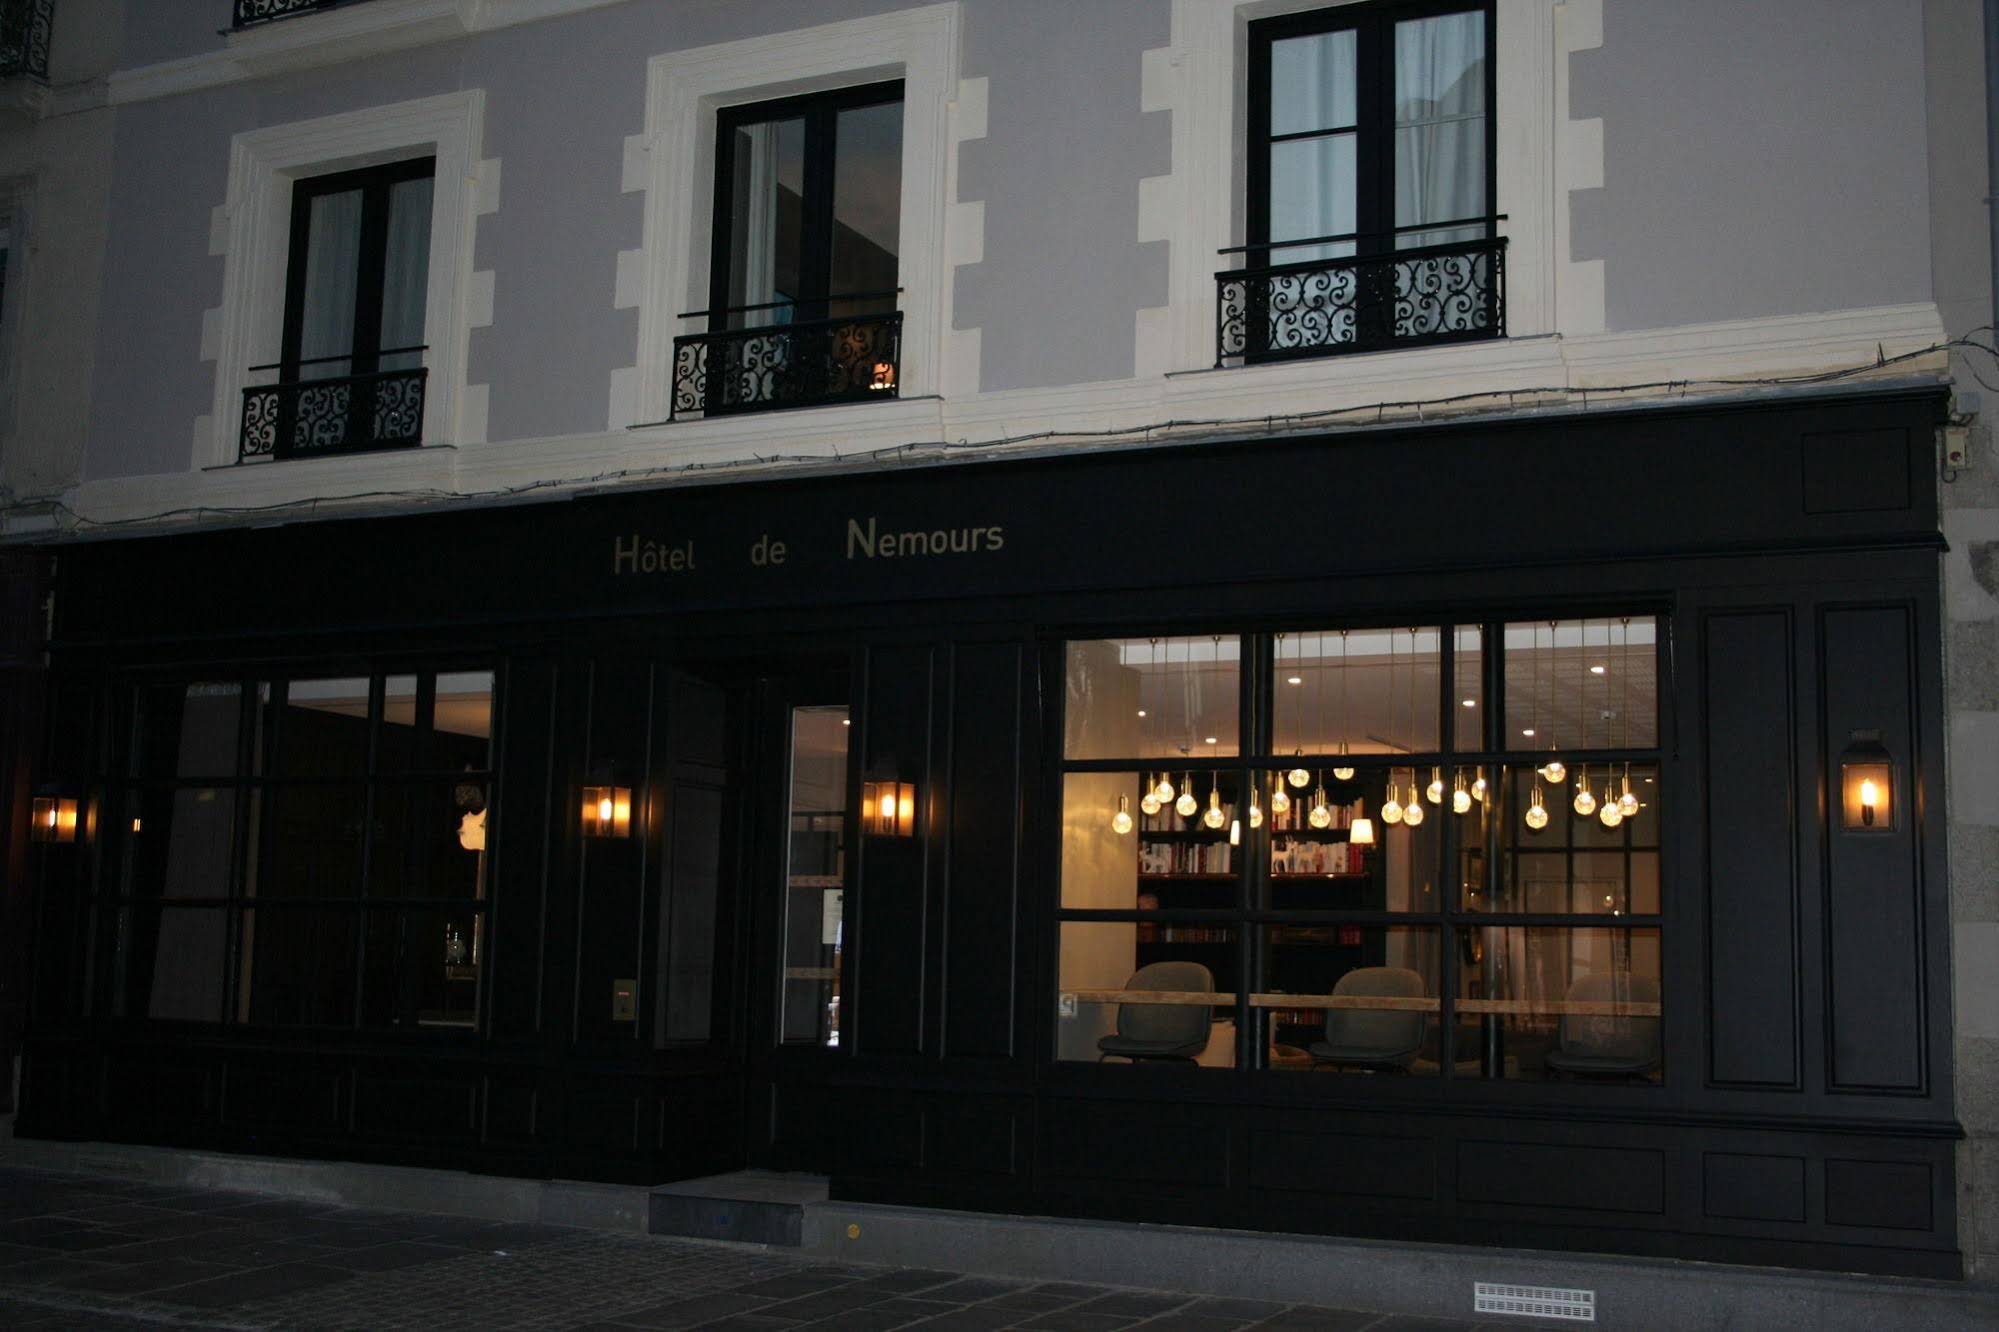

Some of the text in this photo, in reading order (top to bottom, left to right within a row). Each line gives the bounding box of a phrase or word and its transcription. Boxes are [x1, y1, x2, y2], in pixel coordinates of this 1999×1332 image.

[613, 516, 1005, 575] Hôtel de Nemours
